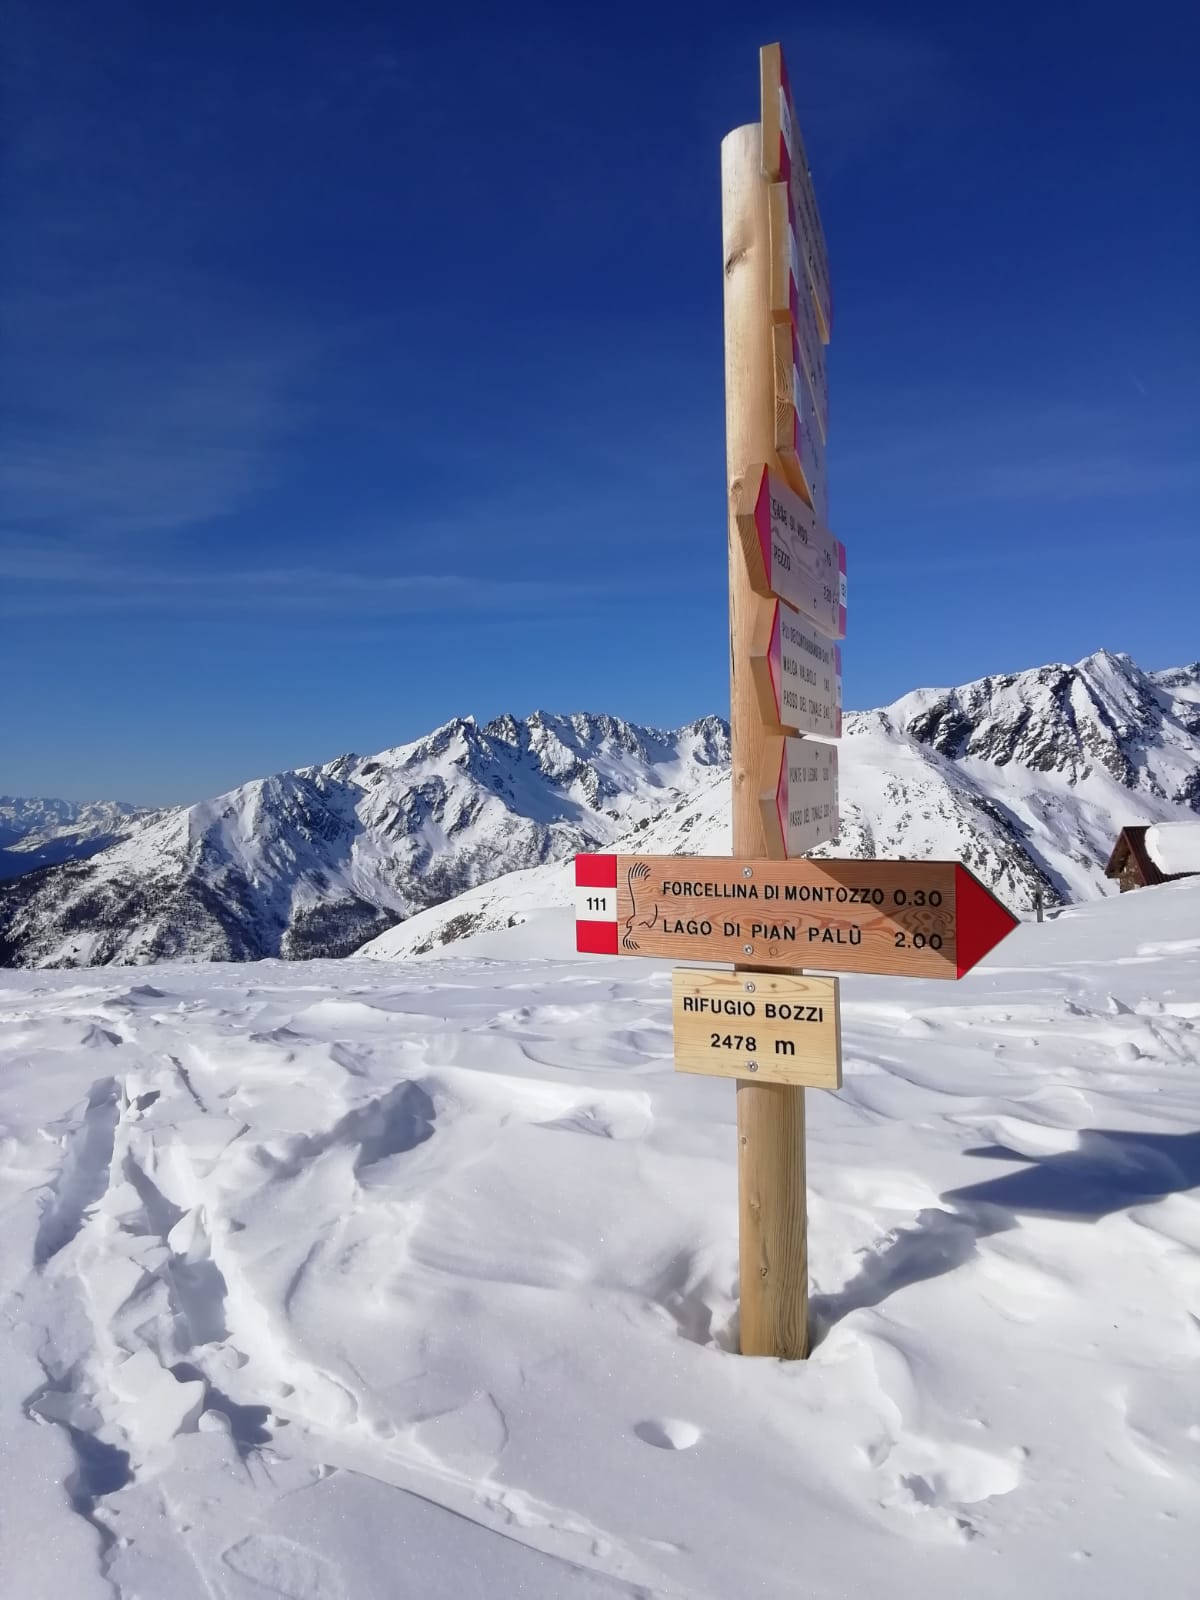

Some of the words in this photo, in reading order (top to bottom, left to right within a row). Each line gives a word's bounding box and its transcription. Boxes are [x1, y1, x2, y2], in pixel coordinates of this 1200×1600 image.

[773, 545, 791, 572] PEZZO
[783, 690, 798, 710] PASSO
[790, 810, 802, 828] PASSO
[586, 897, 607, 912] 111
[662, 881, 759, 900] FORCELLINA
[764, 884, 779, 900] DI
[784, 885, 884, 906] MONTOZZO
[893, 889, 943, 907] 0.30
[663, 919, 713, 937] LAGO
[724, 922, 740, 938] DI
[752, 924, 796, 942] PIAN
[808, 924, 862, 945] PALÙ
[894, 932, 944, 950] 2.00
[683, 996, 756, 1017] RIFUGIO
[765, 1004, 824, 1022] BOZZI
[710, 1033, 757, 1052] 2478
[775, 1040, 796, 1056] m
